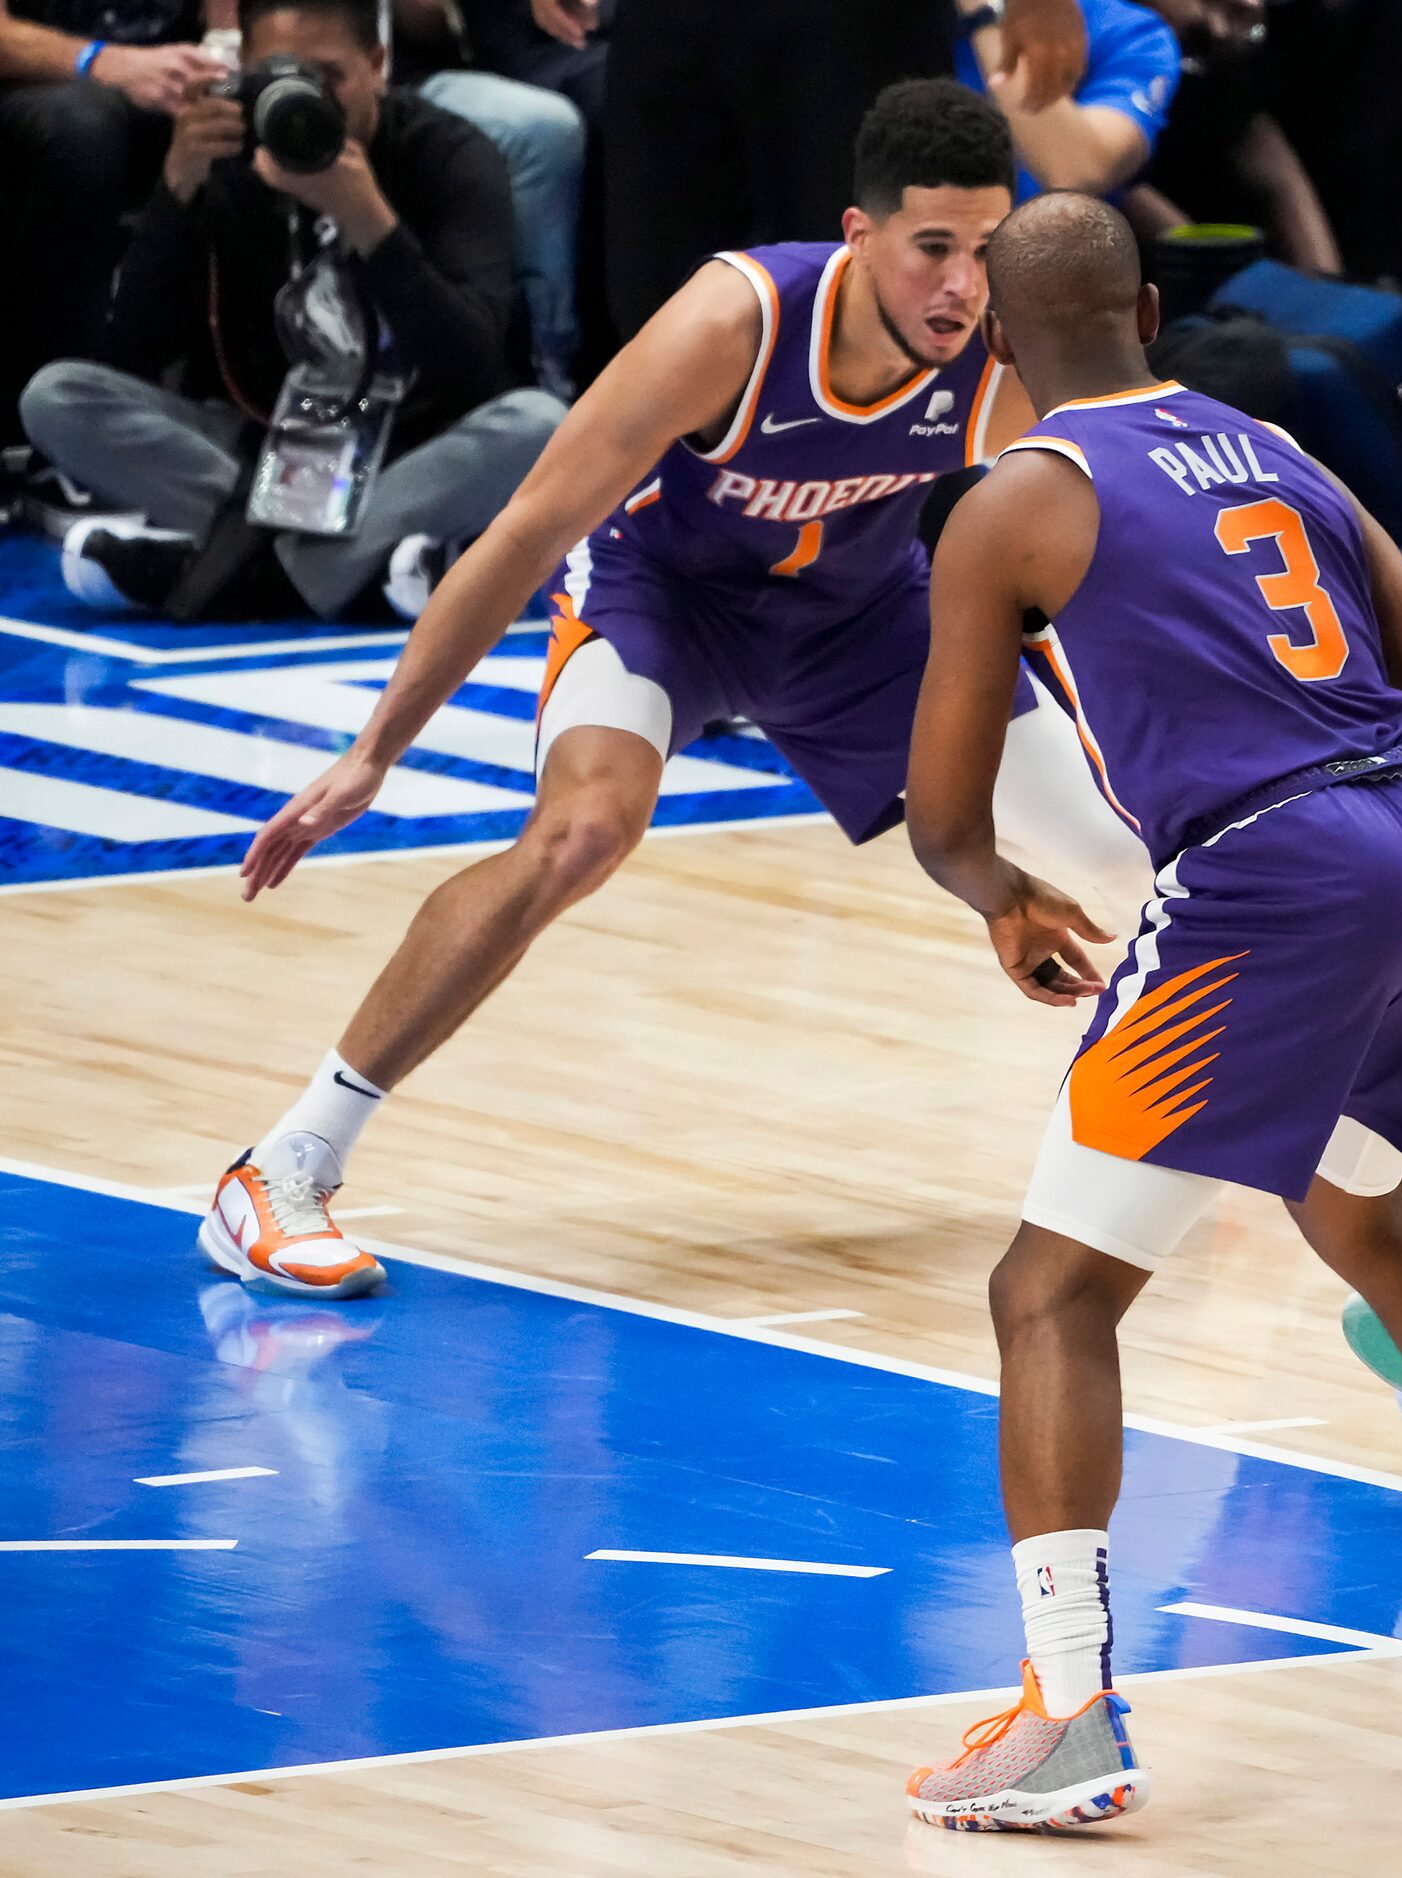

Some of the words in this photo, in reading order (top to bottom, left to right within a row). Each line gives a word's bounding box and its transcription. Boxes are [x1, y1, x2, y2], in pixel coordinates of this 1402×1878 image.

[908, 423, 959, 437] PayPal
[1147, 433, 1280, 496] PAUL
[768, 519, 825, 578] 1
[1213, 496, 1350, 683] 3
